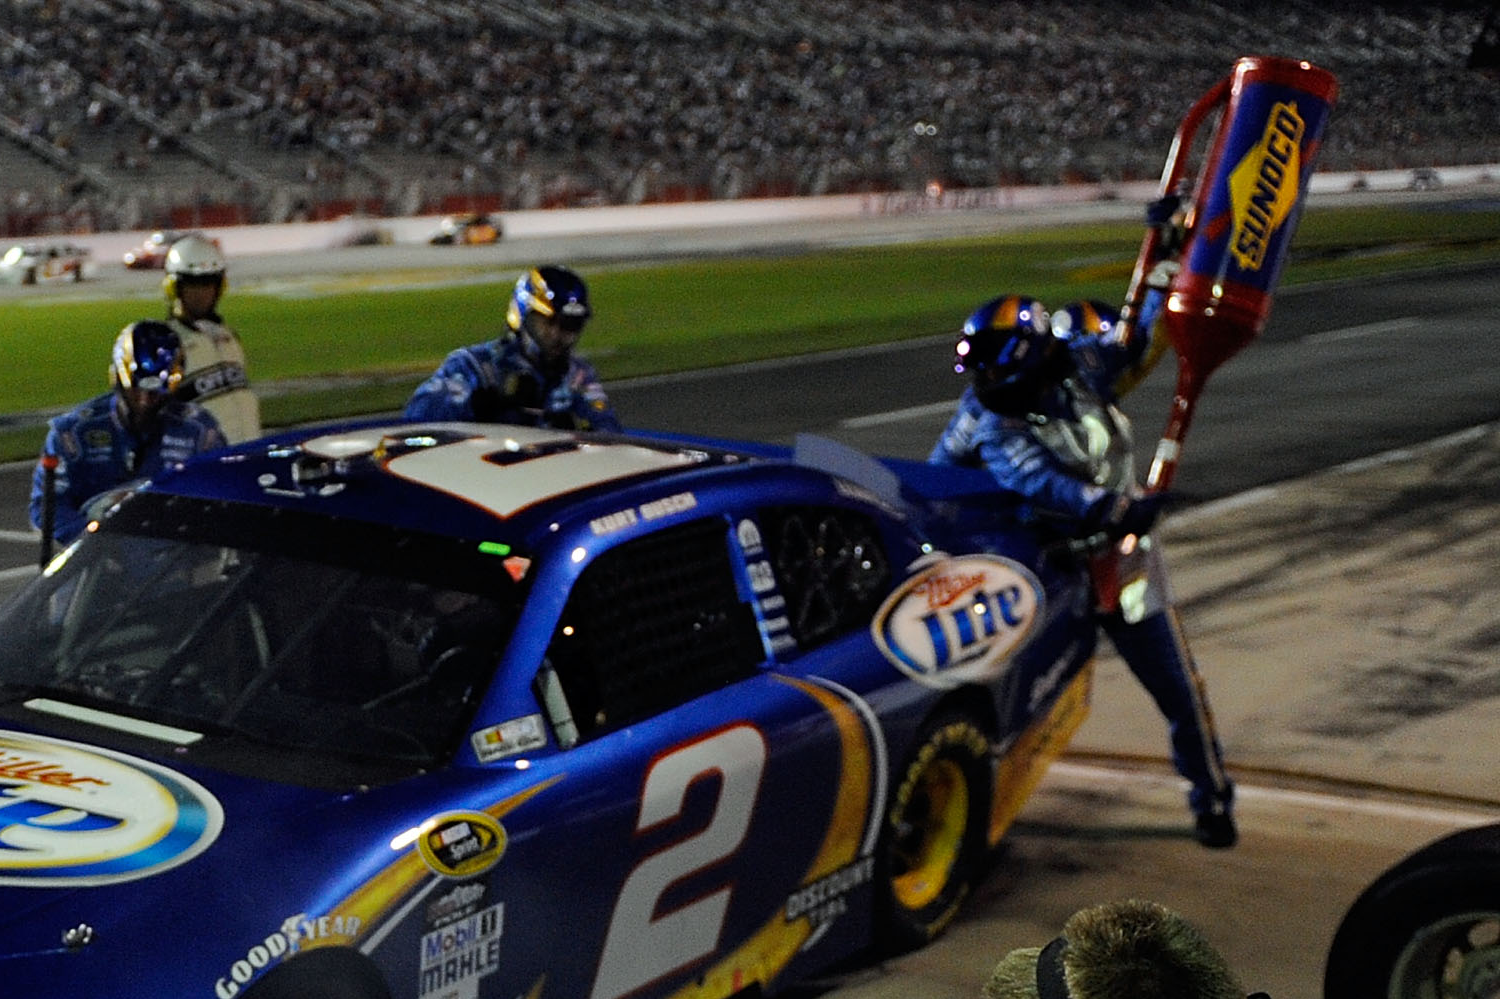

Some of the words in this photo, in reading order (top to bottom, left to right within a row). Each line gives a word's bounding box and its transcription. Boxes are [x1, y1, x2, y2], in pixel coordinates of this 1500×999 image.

[1236, 108, 1299, 263] SUNOCO
[921, 583, 1024, 672] Lite
[420, 940, 500, 997] MAHLE
[425, 916, 477, 957] Mobil
